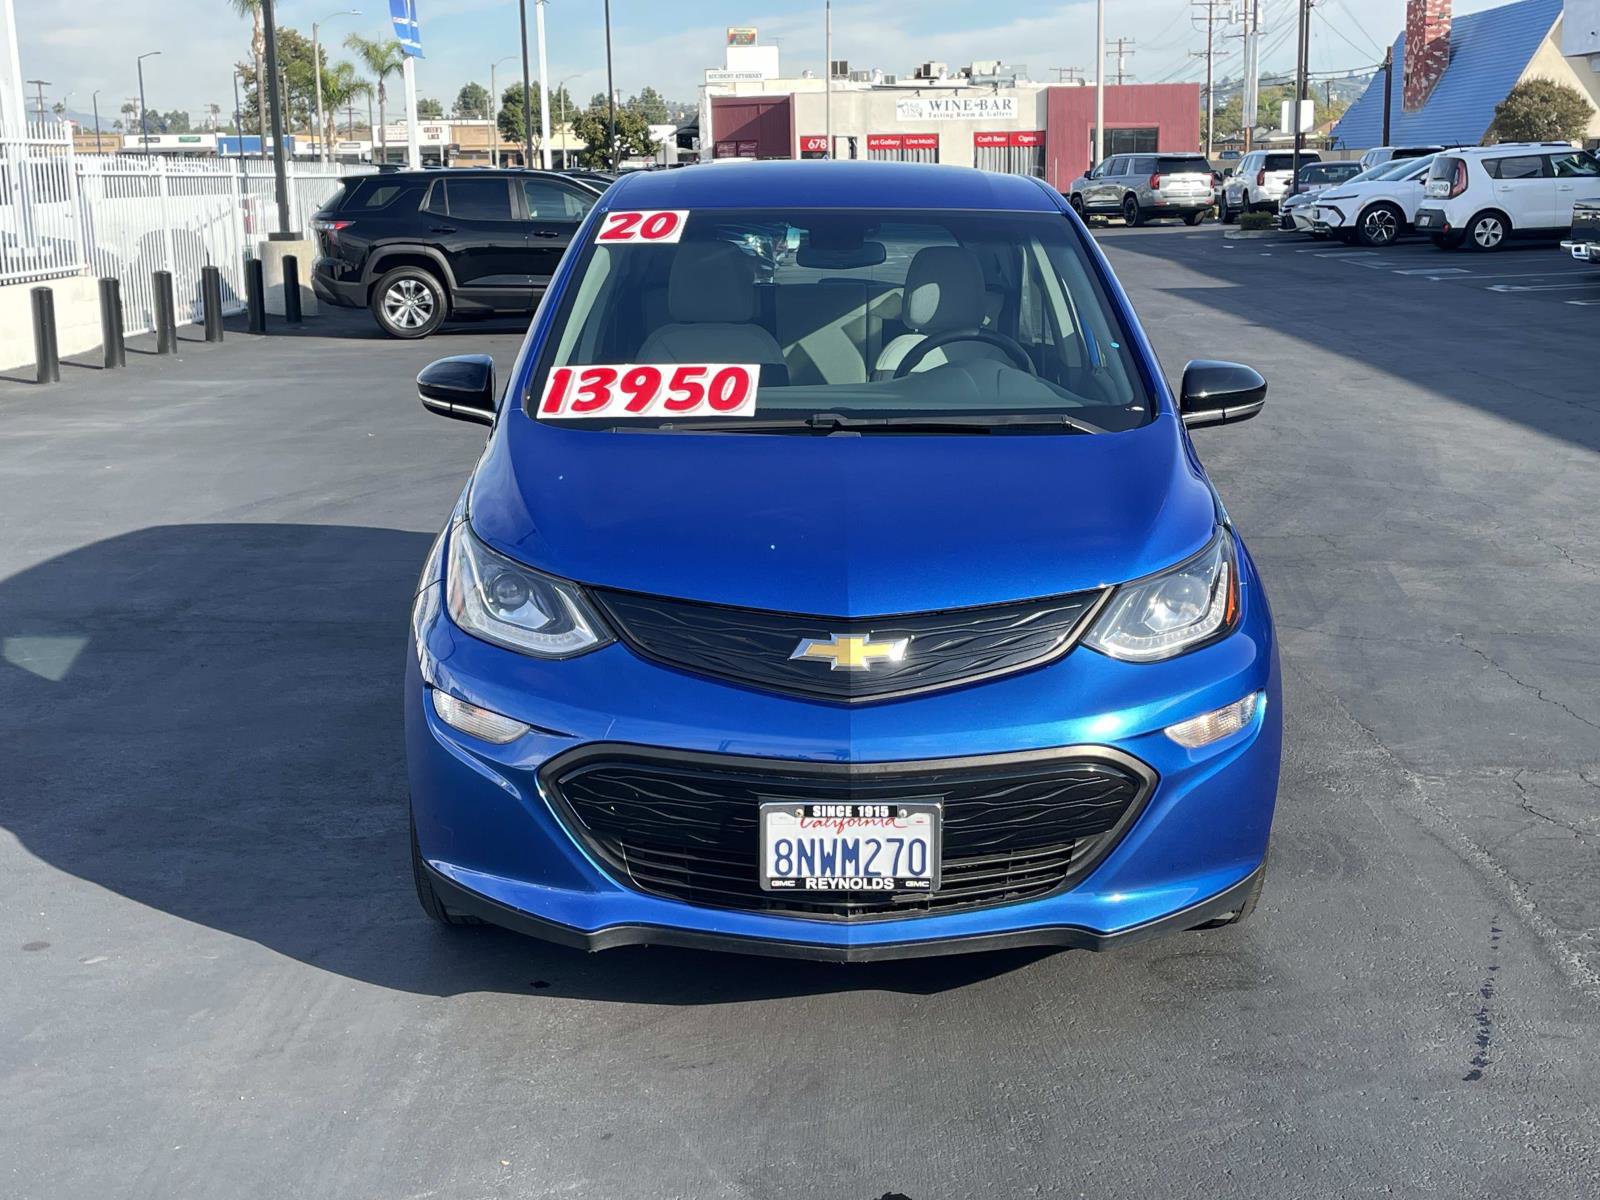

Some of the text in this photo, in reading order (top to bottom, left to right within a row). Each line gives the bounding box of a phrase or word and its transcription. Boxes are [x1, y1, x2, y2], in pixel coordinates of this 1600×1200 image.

[929, 99, 973, 111] WINE
[980, 98, 1012, 110] BAR
[807, 138, 828, 150] 678
[880, 139, 900, 147] Gallery
[977, 135, 992, 143] Craft
[600, 212, 681, 241] 20
[542, 366, 752, 415] 13950
[812, 805, 889, 817] SINCE 1915
[800, 816, 908, 834] California
[774, 837, 927, 877] 8NWM270
[771, 877, 930, 890] GMC REYNOLDS GMC
